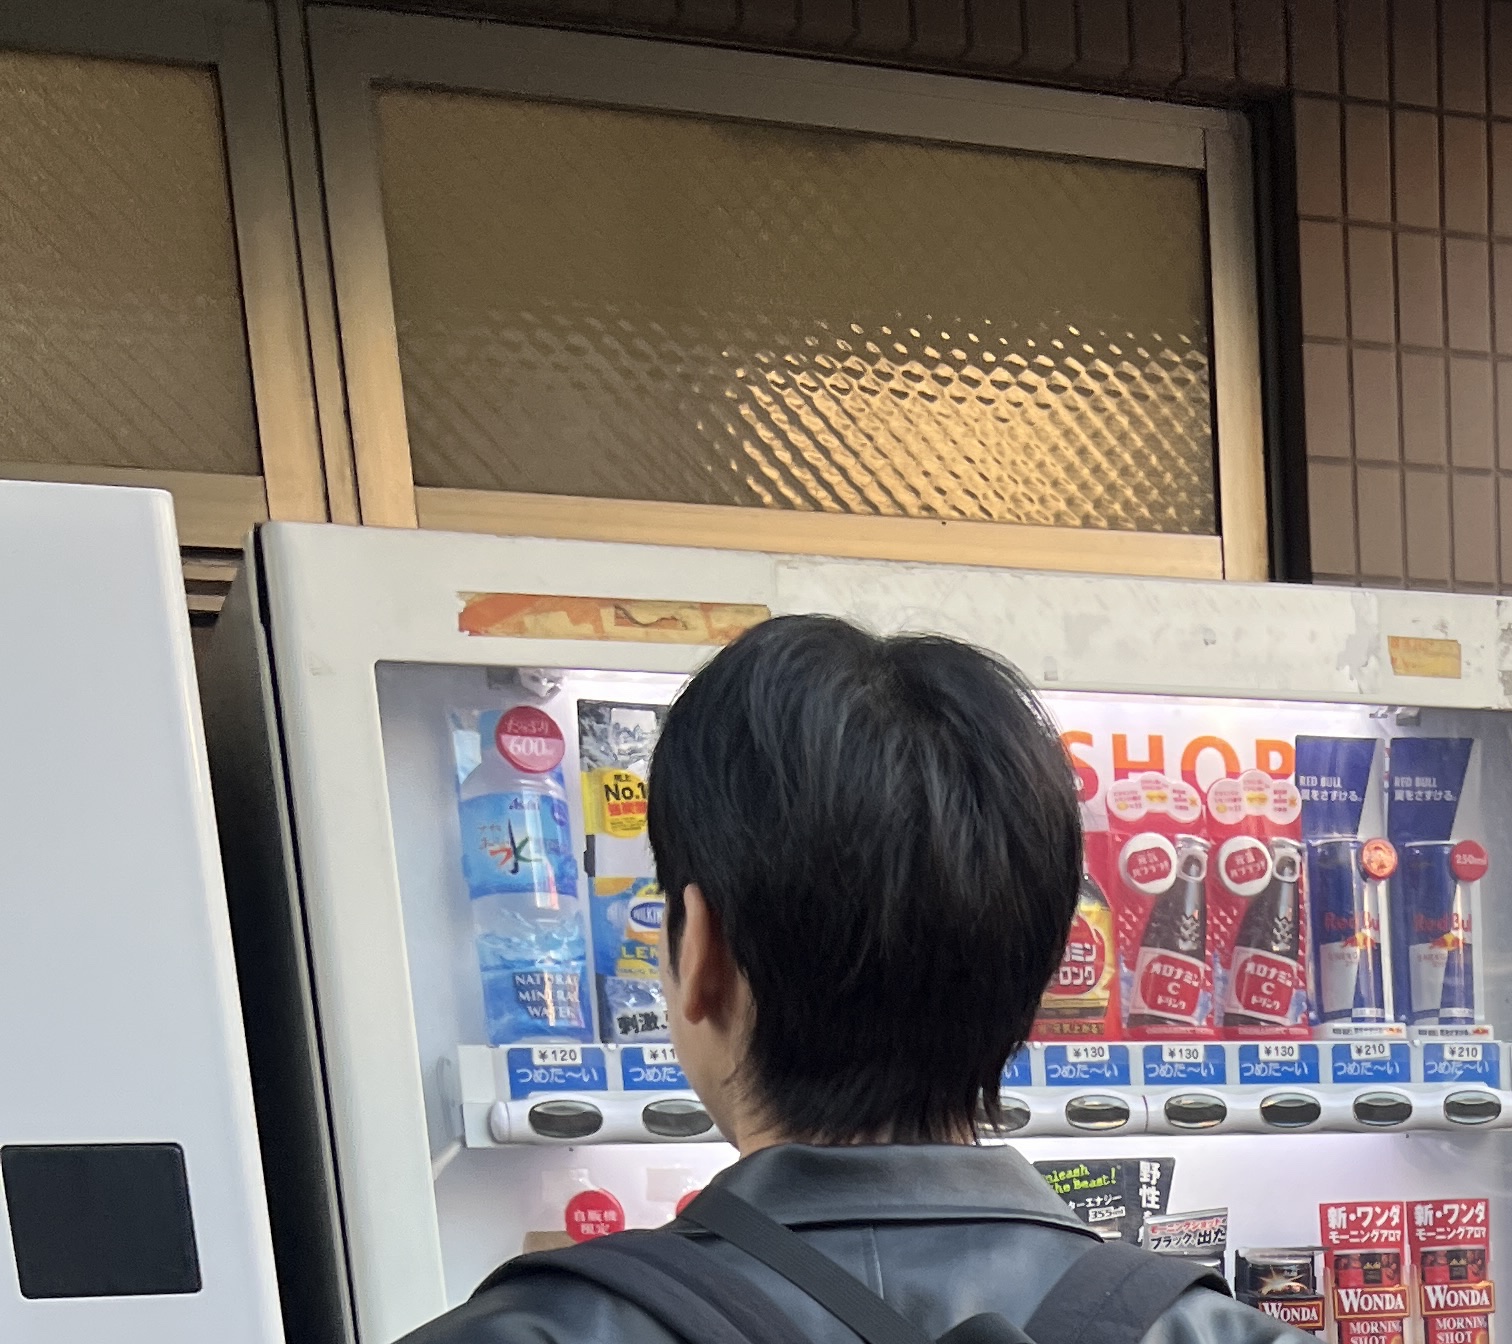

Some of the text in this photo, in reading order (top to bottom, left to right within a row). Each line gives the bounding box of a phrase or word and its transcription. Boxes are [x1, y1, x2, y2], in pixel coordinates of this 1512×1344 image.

[509, 738, 554, 756] 600
[604, 782, 647, 802] No.1
[1151, 962, 1201, 988] オロナミン
[1245, 961, 1294, 988] オロナミン
[1167, 982, 1180, 996] C
[1261, 982, 1275, 996] C
[1156, 994, 1187, 1011] ドリンク
[1251, 994, 1281, 1011] ドリンク
[538, 1050, 577, 1062] ¥120
[650, 1050, 676, 1061] ¥11
[1073, 1047, 1105, 1059] ¥130
[1167, 1048, 1199, 1061] ¥130
[1264, 1046, 1296, 1058] ¥130
[1355, 1043, 1386, 1057] ¥210
[1449, 1046, 1478, 1059] ¥210
[629, 1067, 686, 1083] つめた〜
[1043, 1164, 1089, 1184] nleash
[1327, 1206, 1401, 1229] 新・ワンダ
[1413, 1201, 1487, 1227] 新・ワンダ
[1337, 1288, 1405, 1314] WONDA
[1424, 1284, 1491, 1309] WONDA
[1261, 1301, 1319, 1322] WONDA
[1435, 1330, 1474, 1344] SHOT
